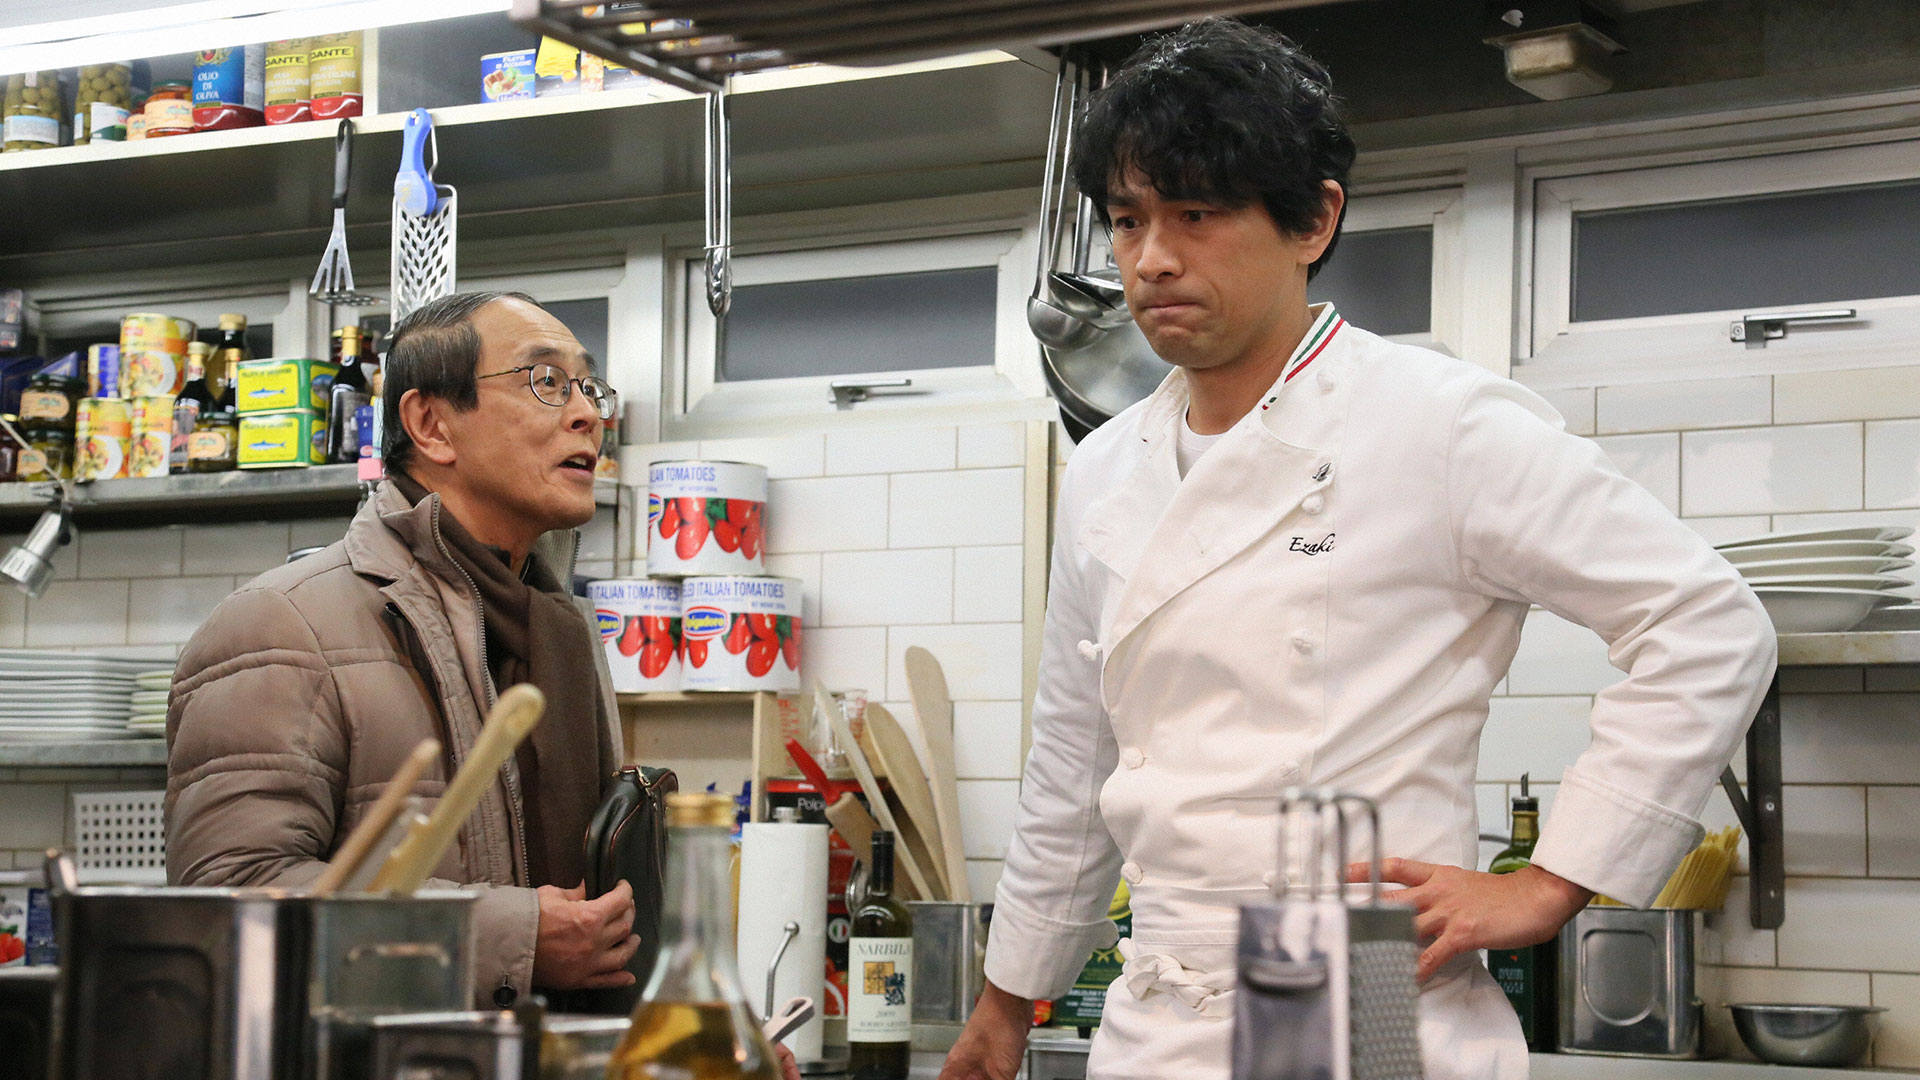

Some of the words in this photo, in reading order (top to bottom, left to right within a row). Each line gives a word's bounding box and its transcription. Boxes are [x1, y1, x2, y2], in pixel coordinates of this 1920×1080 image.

[311, 48, 351, 60] DANTE
[264, 55, 305, 67] DANTE
[198, 71, 219, 82] OLIO
[202, 82, 213, 91] DI
[196, 91, 220, 101] OLIVA
[666, 466, 716, 481] TOMATOES
[1289, 533, 1335, 556] Ezaki
[594, 585, 624, 600] ITALIAN
[627, 585, 679, 601] TOMATOES
[697, 582, 731, 597] ITALIAN
[734, 582, 785, 598] TOMATOES
